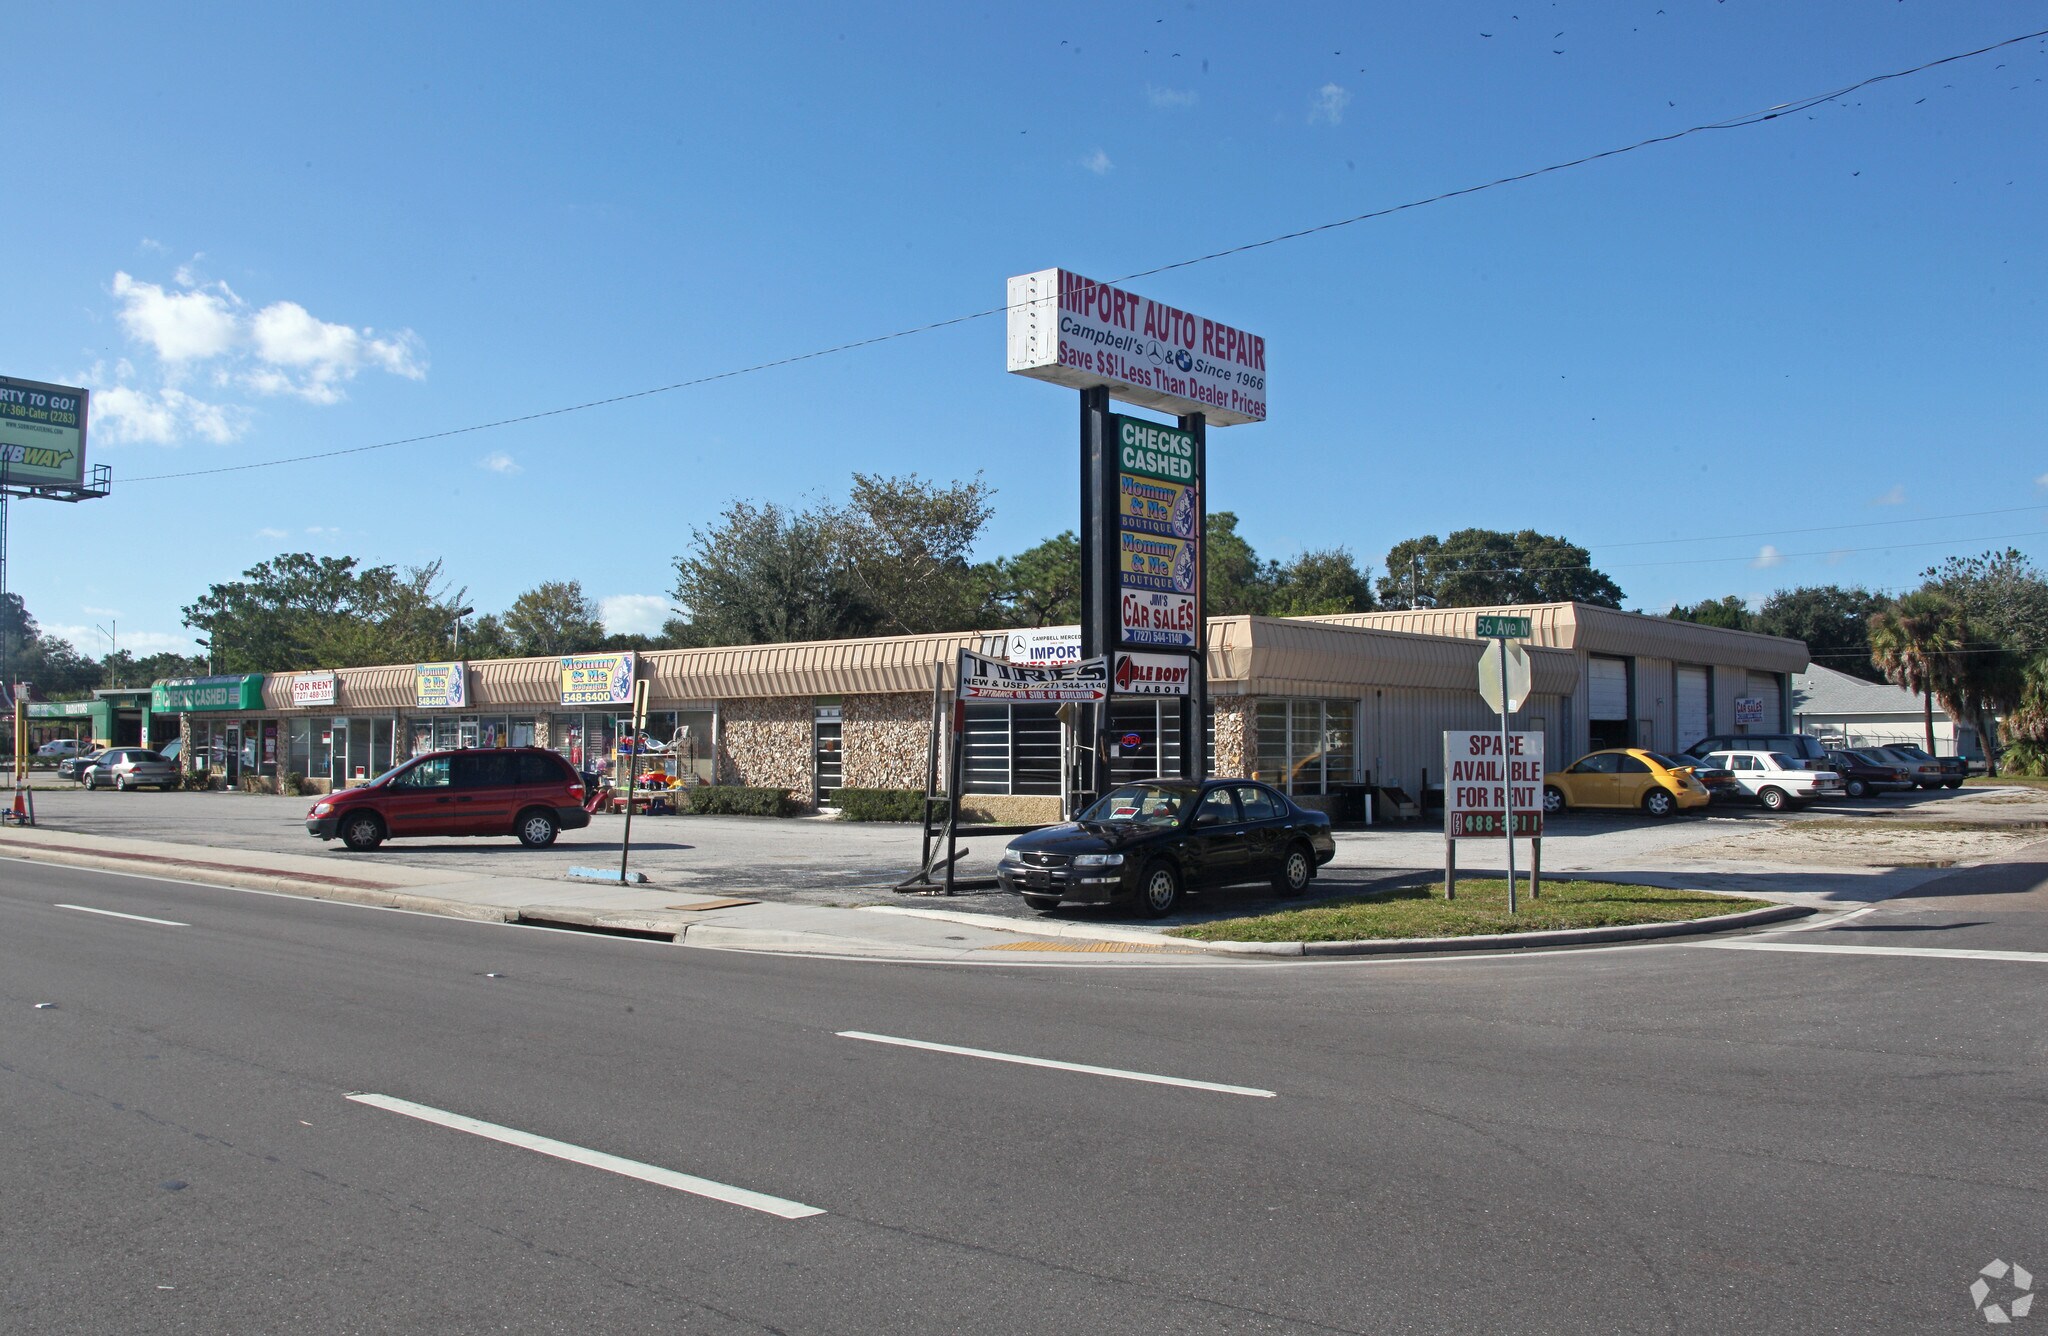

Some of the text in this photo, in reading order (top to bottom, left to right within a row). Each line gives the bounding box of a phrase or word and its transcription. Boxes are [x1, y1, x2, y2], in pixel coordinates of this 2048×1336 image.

[1058, 269, 1265, 372] IMPORT AUTO REPAIR
[1060, 316, 1264, 390] Campbell's & Since 1966
[1058, 341, 1266, 418] Save $$! Less Than Dealer Prices
[0, 388, 75, 411] RTY TO GO!
[0, 402, 76, 425] 7-360-Cater (2283)
[1122, 423, 1192, 457] CHECKS
[1122, 447, 1192, 478] CASHED
[1121, 476, 1177, 507] Mommy
[1130, 497, 1167, 520] & Me
[1122, 517, 1172, 533] BOUTIQUE
[1122, 533, 1177, 561] Mommy
[1131, 554, 1169, 575] & Me
[1123, 574, 1172, 588] BOUTIQUE
[1150, 593, 1168, 607] JIM'S
[1123, 595, 1193, 631] CAR SALES
[1477, 618, 1528, 636] 56 Ave N
[1133, 630, 1183, 644] (727) 544-1140
[418, 665, 450, 679] Mommy
[561, 657, 617, 671] Mommy
[964, 653, 1106, 682] TIRES
[433, 677, 445, 688] Me
[571, 670, 608, 682] & Me
[1155, 667, 1188, 682] BODY
[294, 680, 333, 691] FOR RENT
[963, 677, 991, 687] NEW
[1002, 681, 1030, 689] USED
[1135, 685, 1181, 693] LABOR
[163, 690, 193, 707] CHECKS
[195, 688, 227, 706] CASHED
[294, 690, 334, 700] (727) 488-3311
[418, 697, 447, 705] 548-6400
[563, 692, 611, 702] 548-6400
[978, 688, 1094, 699] ENTRANCE ON SIDE OF BUILDING
[1122, 736, 1141, 744] OPEN
[1457, 787, 1488, 807] FOR
